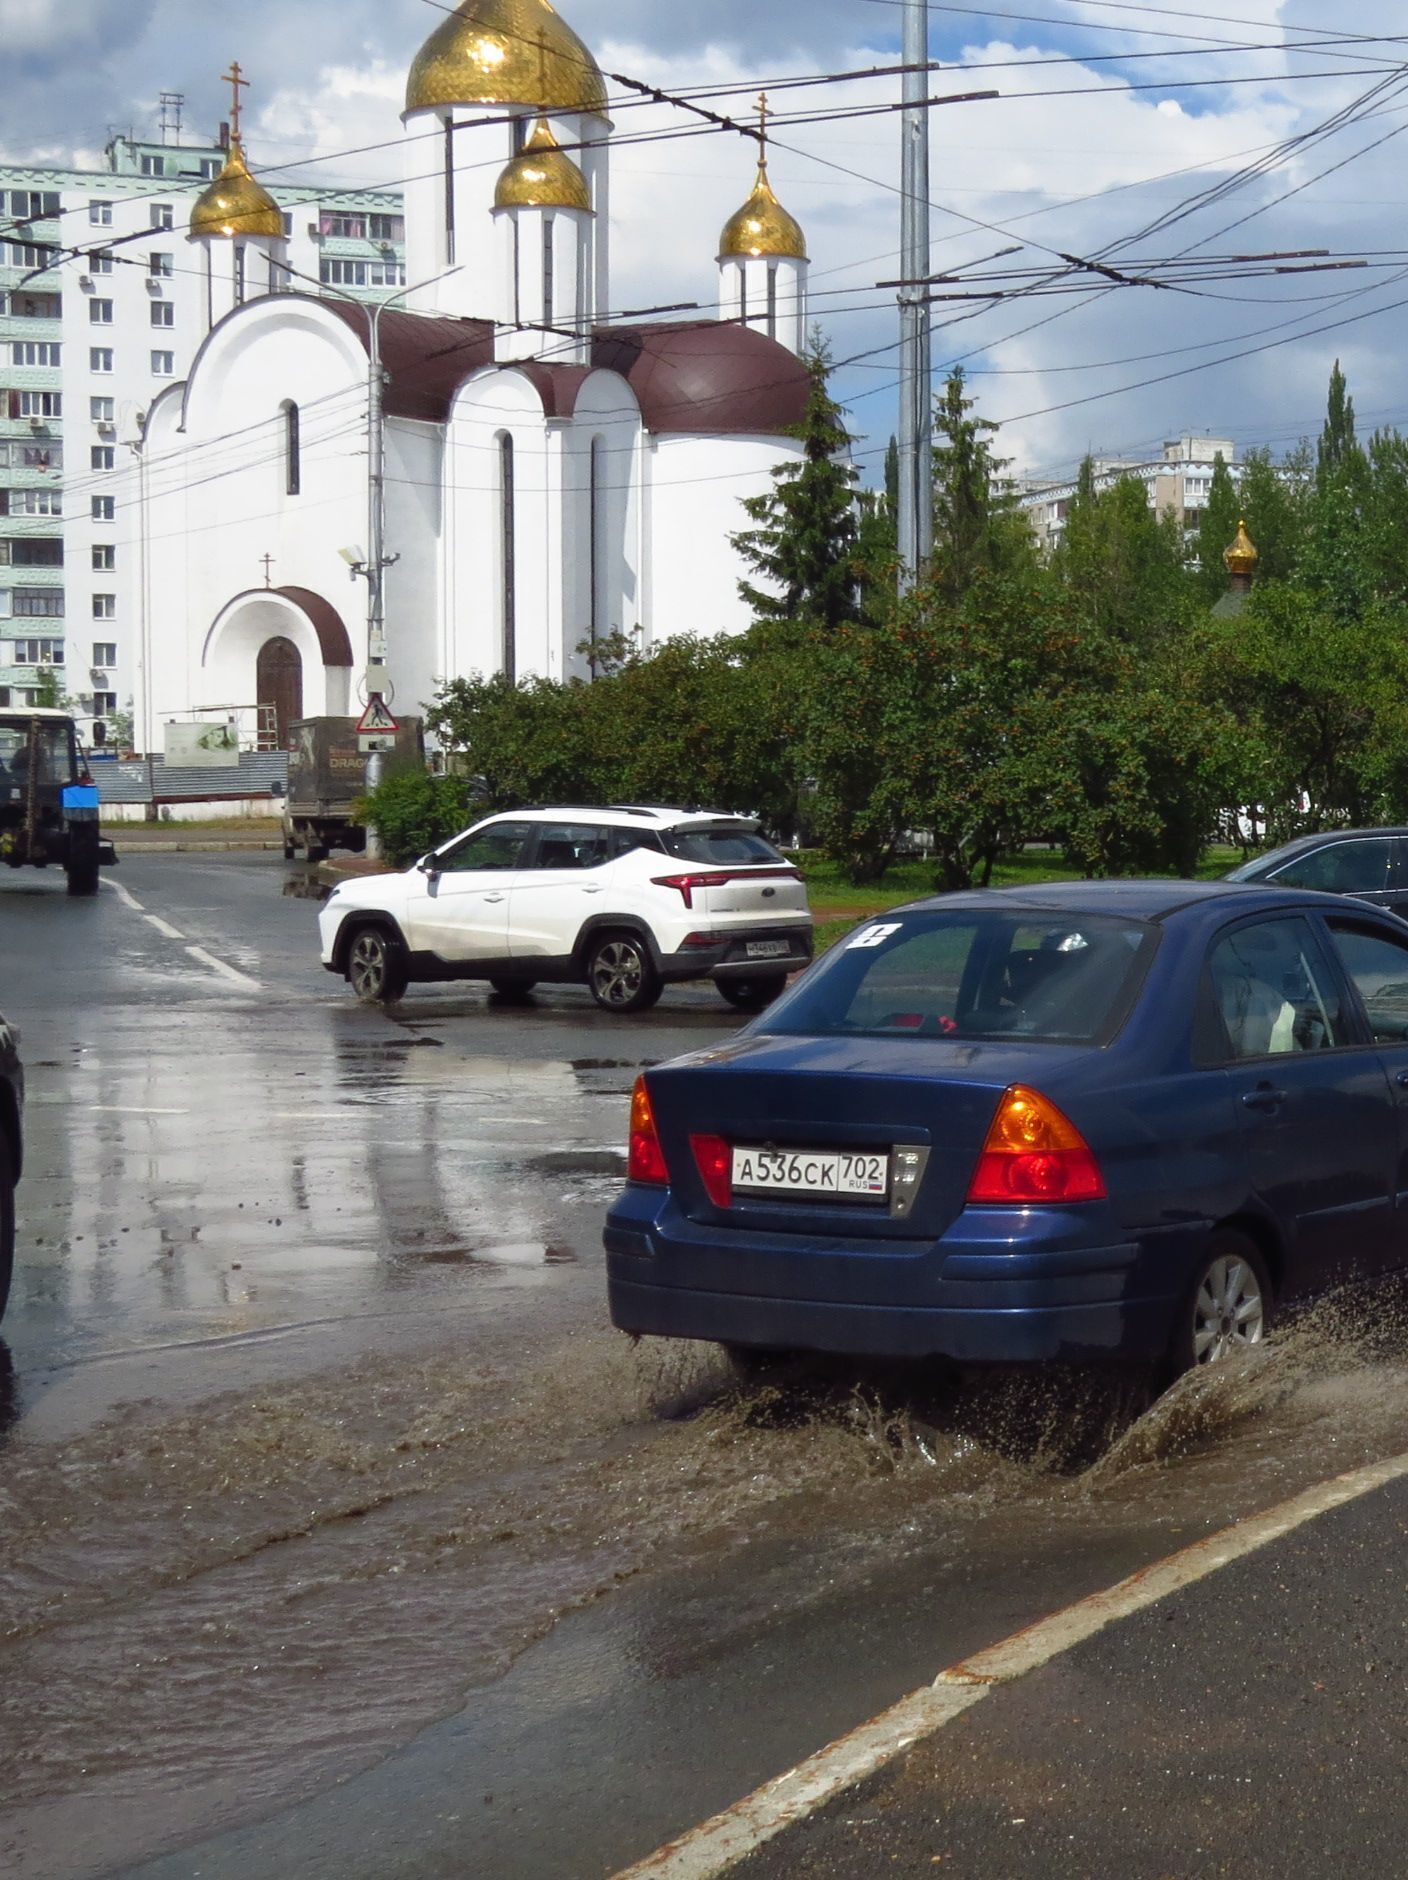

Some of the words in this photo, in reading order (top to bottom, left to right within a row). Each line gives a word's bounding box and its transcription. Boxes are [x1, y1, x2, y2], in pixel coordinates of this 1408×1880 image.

[329, 757, 368, 769] DRAG
[841, 1155, 881, 1181] 702
[848, 1180, 869, 1189] RUS
